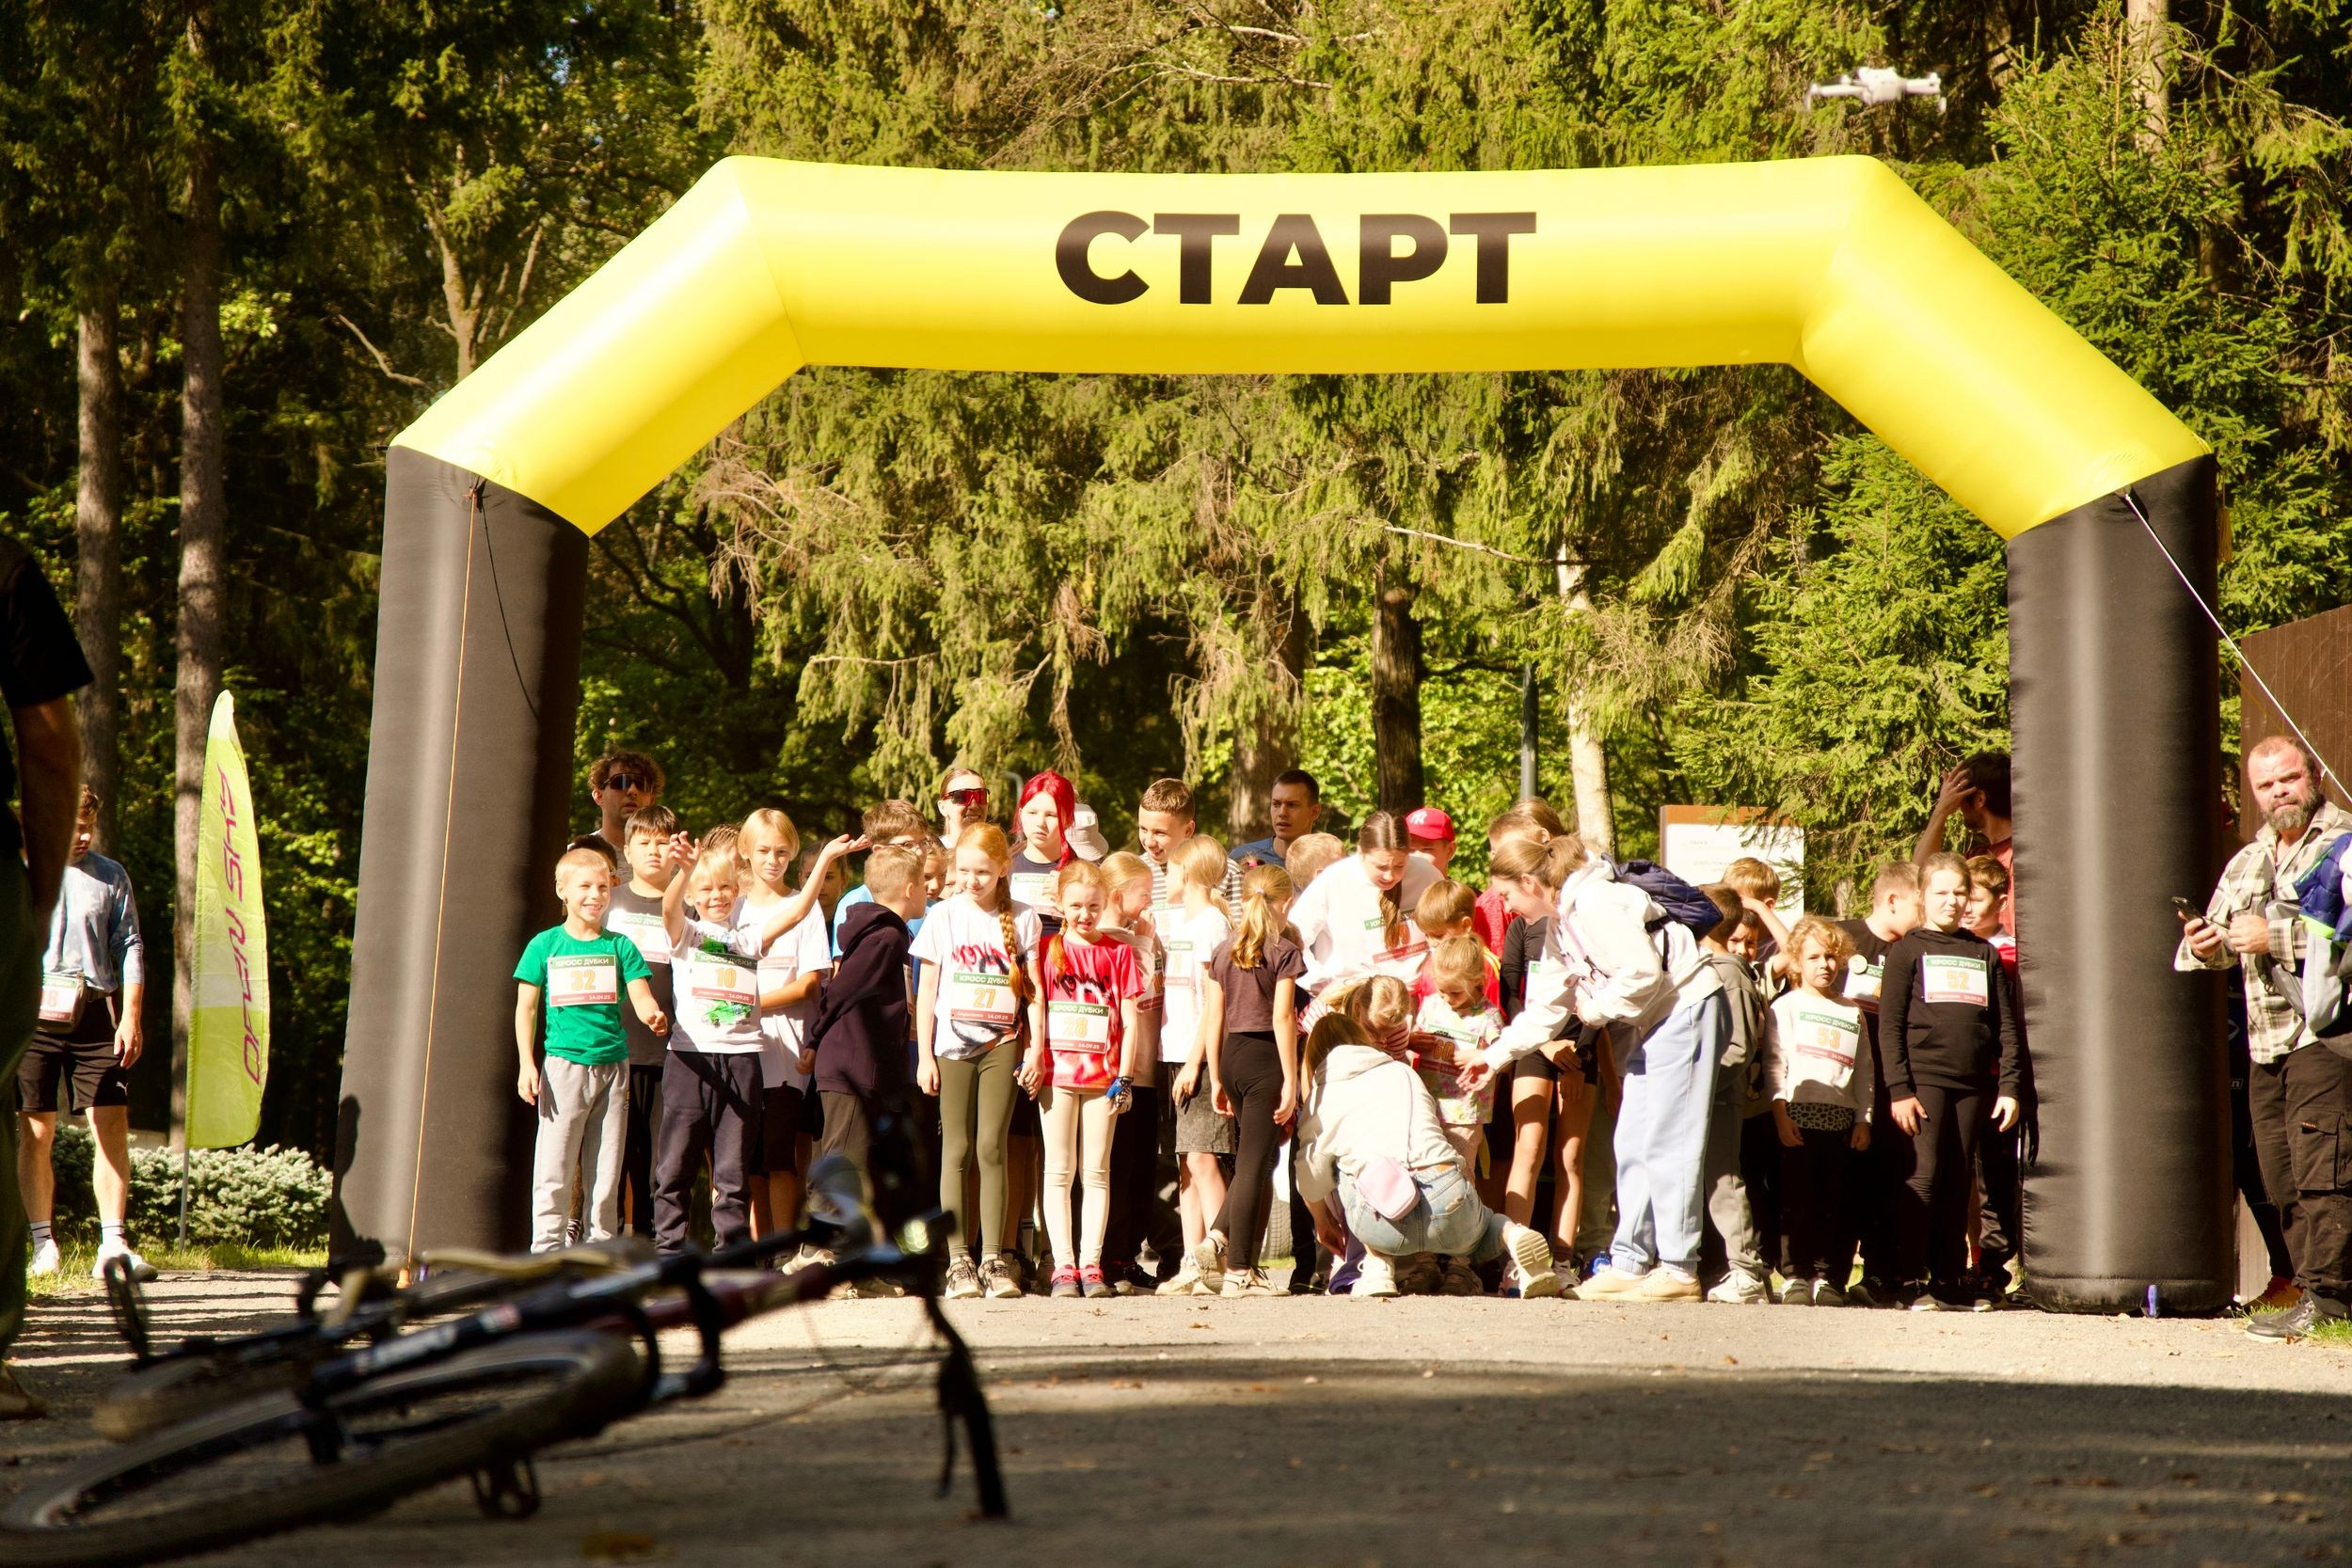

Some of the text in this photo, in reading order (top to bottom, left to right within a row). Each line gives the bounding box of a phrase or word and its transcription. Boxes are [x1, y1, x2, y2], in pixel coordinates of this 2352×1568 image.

[1056, 210, 1536, 305] СТАРТ
[216, 762, 261, 1085] OPEN SKY
[583, 958, 610, 966] ДУБКИ
[571, 969, 596, 991] 32
[715, 967, 737, 989] 10
[1947, 970, 1970, 990] 52
[974, 987, 996, 1009] 27
[1078, 1006, 1104, 1014] ДУБКИ
[1063, 1016, 1089, 1038] 28
[1832, 1019, 1854, 1031] ДУБКИ
[1817, 1025, 1841, 1050] 53
[1433, 1038, 1455, 1062] 60
